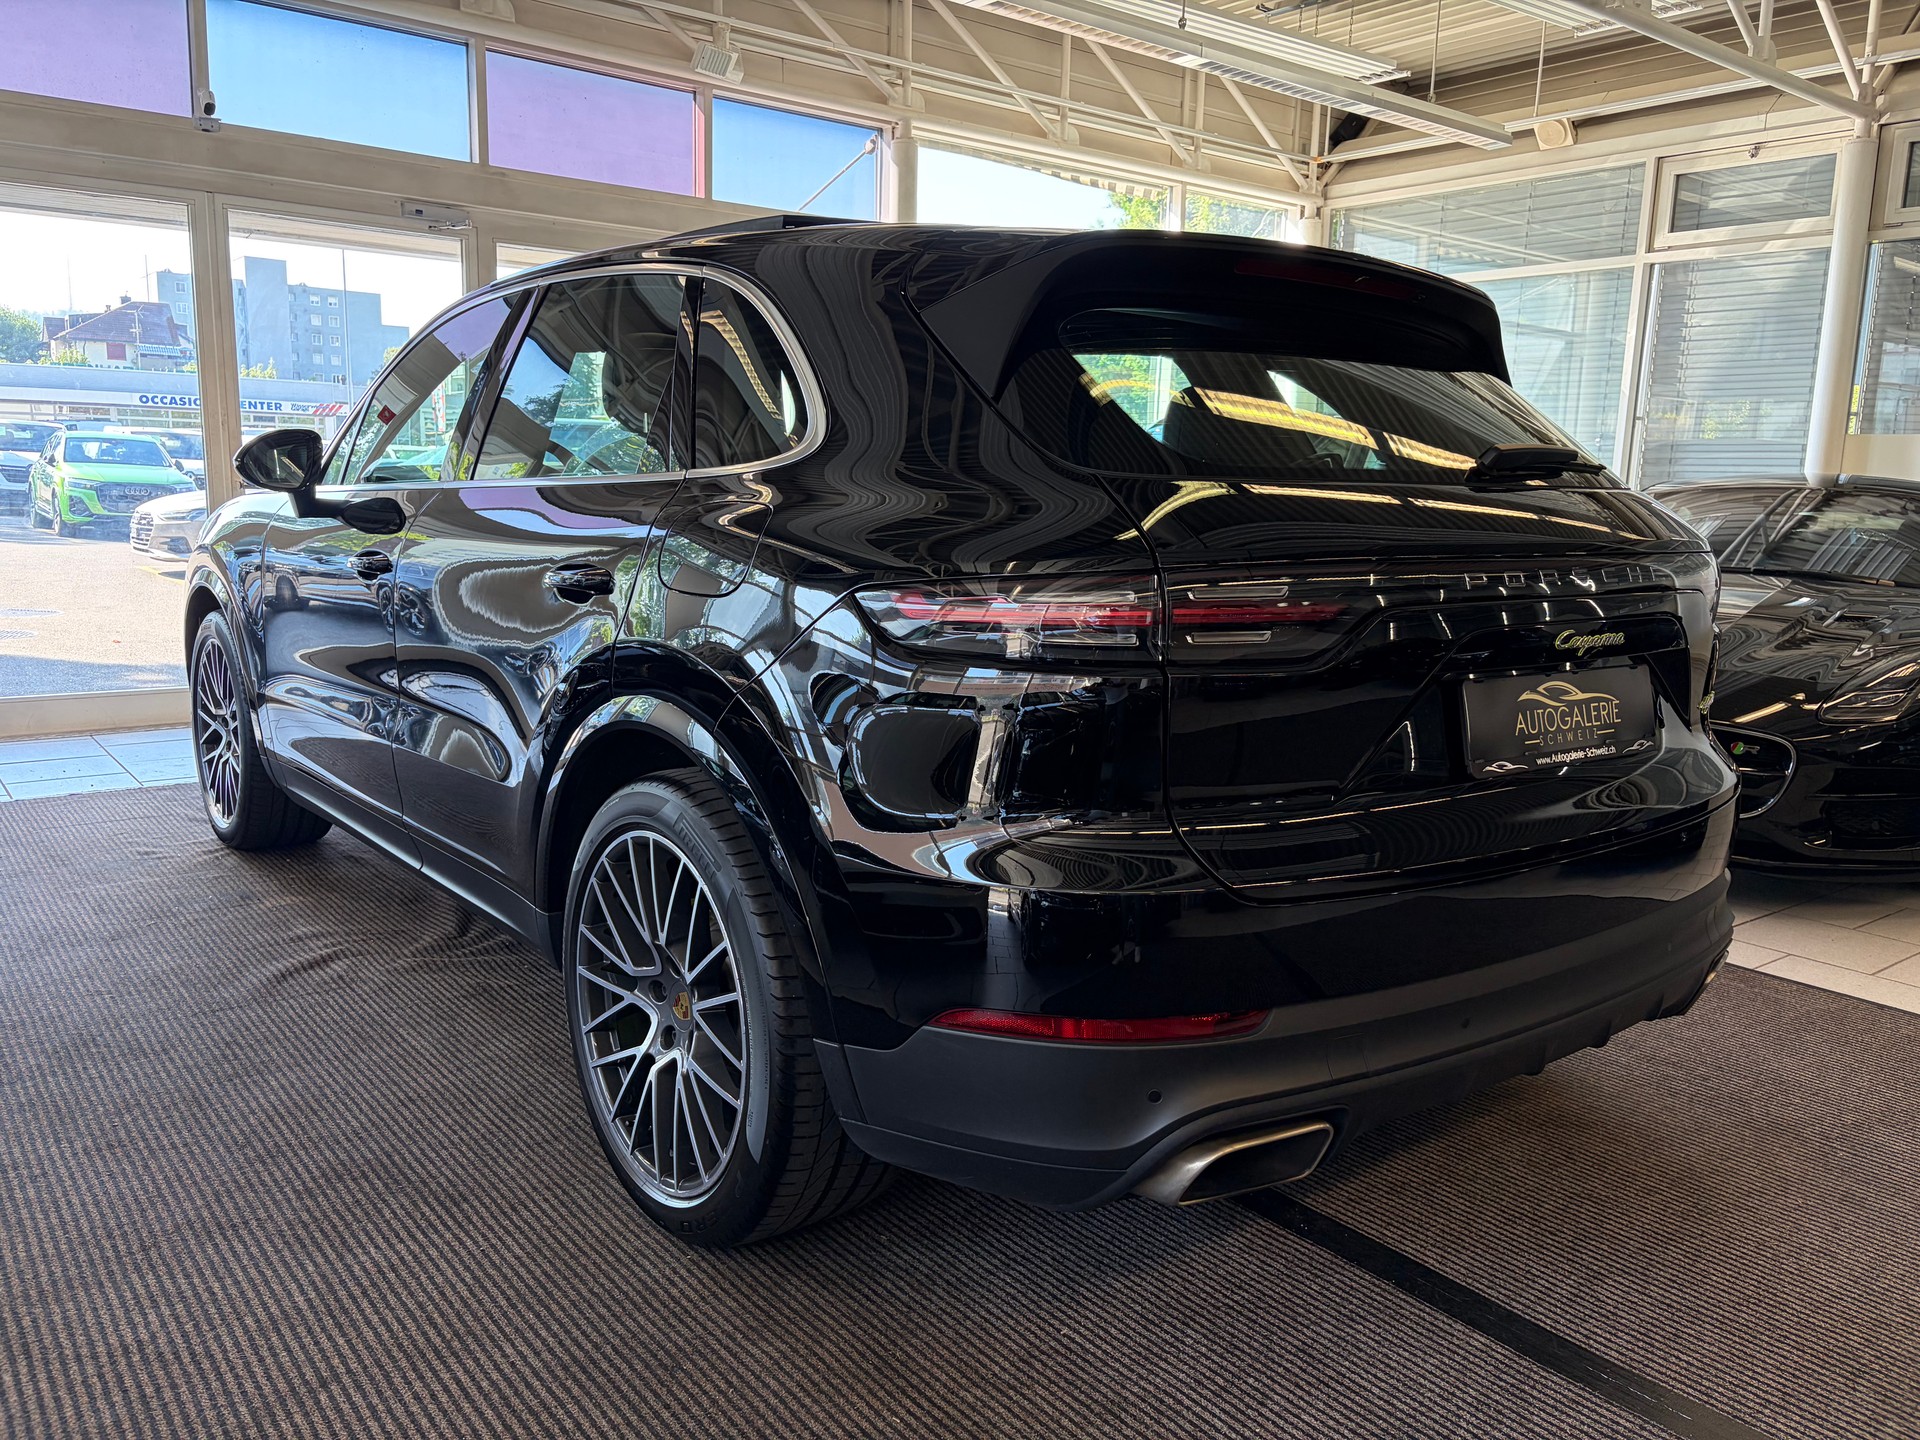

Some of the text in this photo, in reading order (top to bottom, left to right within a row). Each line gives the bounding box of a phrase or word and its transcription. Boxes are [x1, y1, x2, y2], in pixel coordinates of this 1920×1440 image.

[138, 394, 201, 407] OCCASIO
[240, 400, 283, 412] ENTER
[1555, 629, 1626, 657] Cayenne
[1515, 700, 1622, 736] AUTOGALERIE
[1540, 728, 1598, 746] SCHWEIZ
[1536, 745, 1617, 766] www.Autogalerie-Schweiz.ch
[672, 811, 723, 880] PIRELLI
